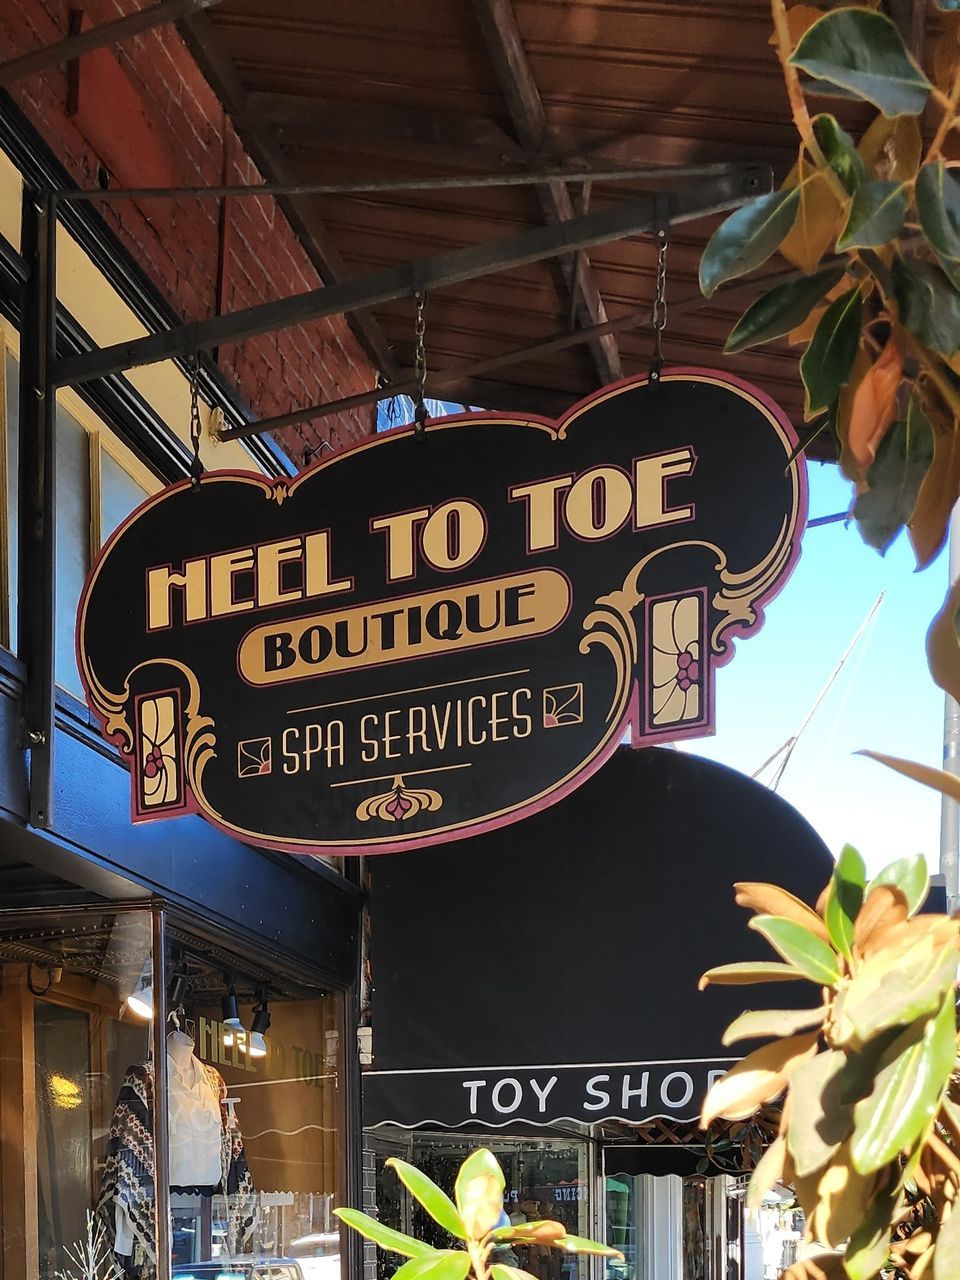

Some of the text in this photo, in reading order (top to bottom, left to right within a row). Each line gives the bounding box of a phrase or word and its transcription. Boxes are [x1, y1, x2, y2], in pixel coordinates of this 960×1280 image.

[149, 450, 695, 629] HEEL TO TOE
[264, 582, 536, 672] BOUTIQUE
[281, 688, 532, 775] SPA SERVICES
[463, 1076, 558, 1114] TOY
